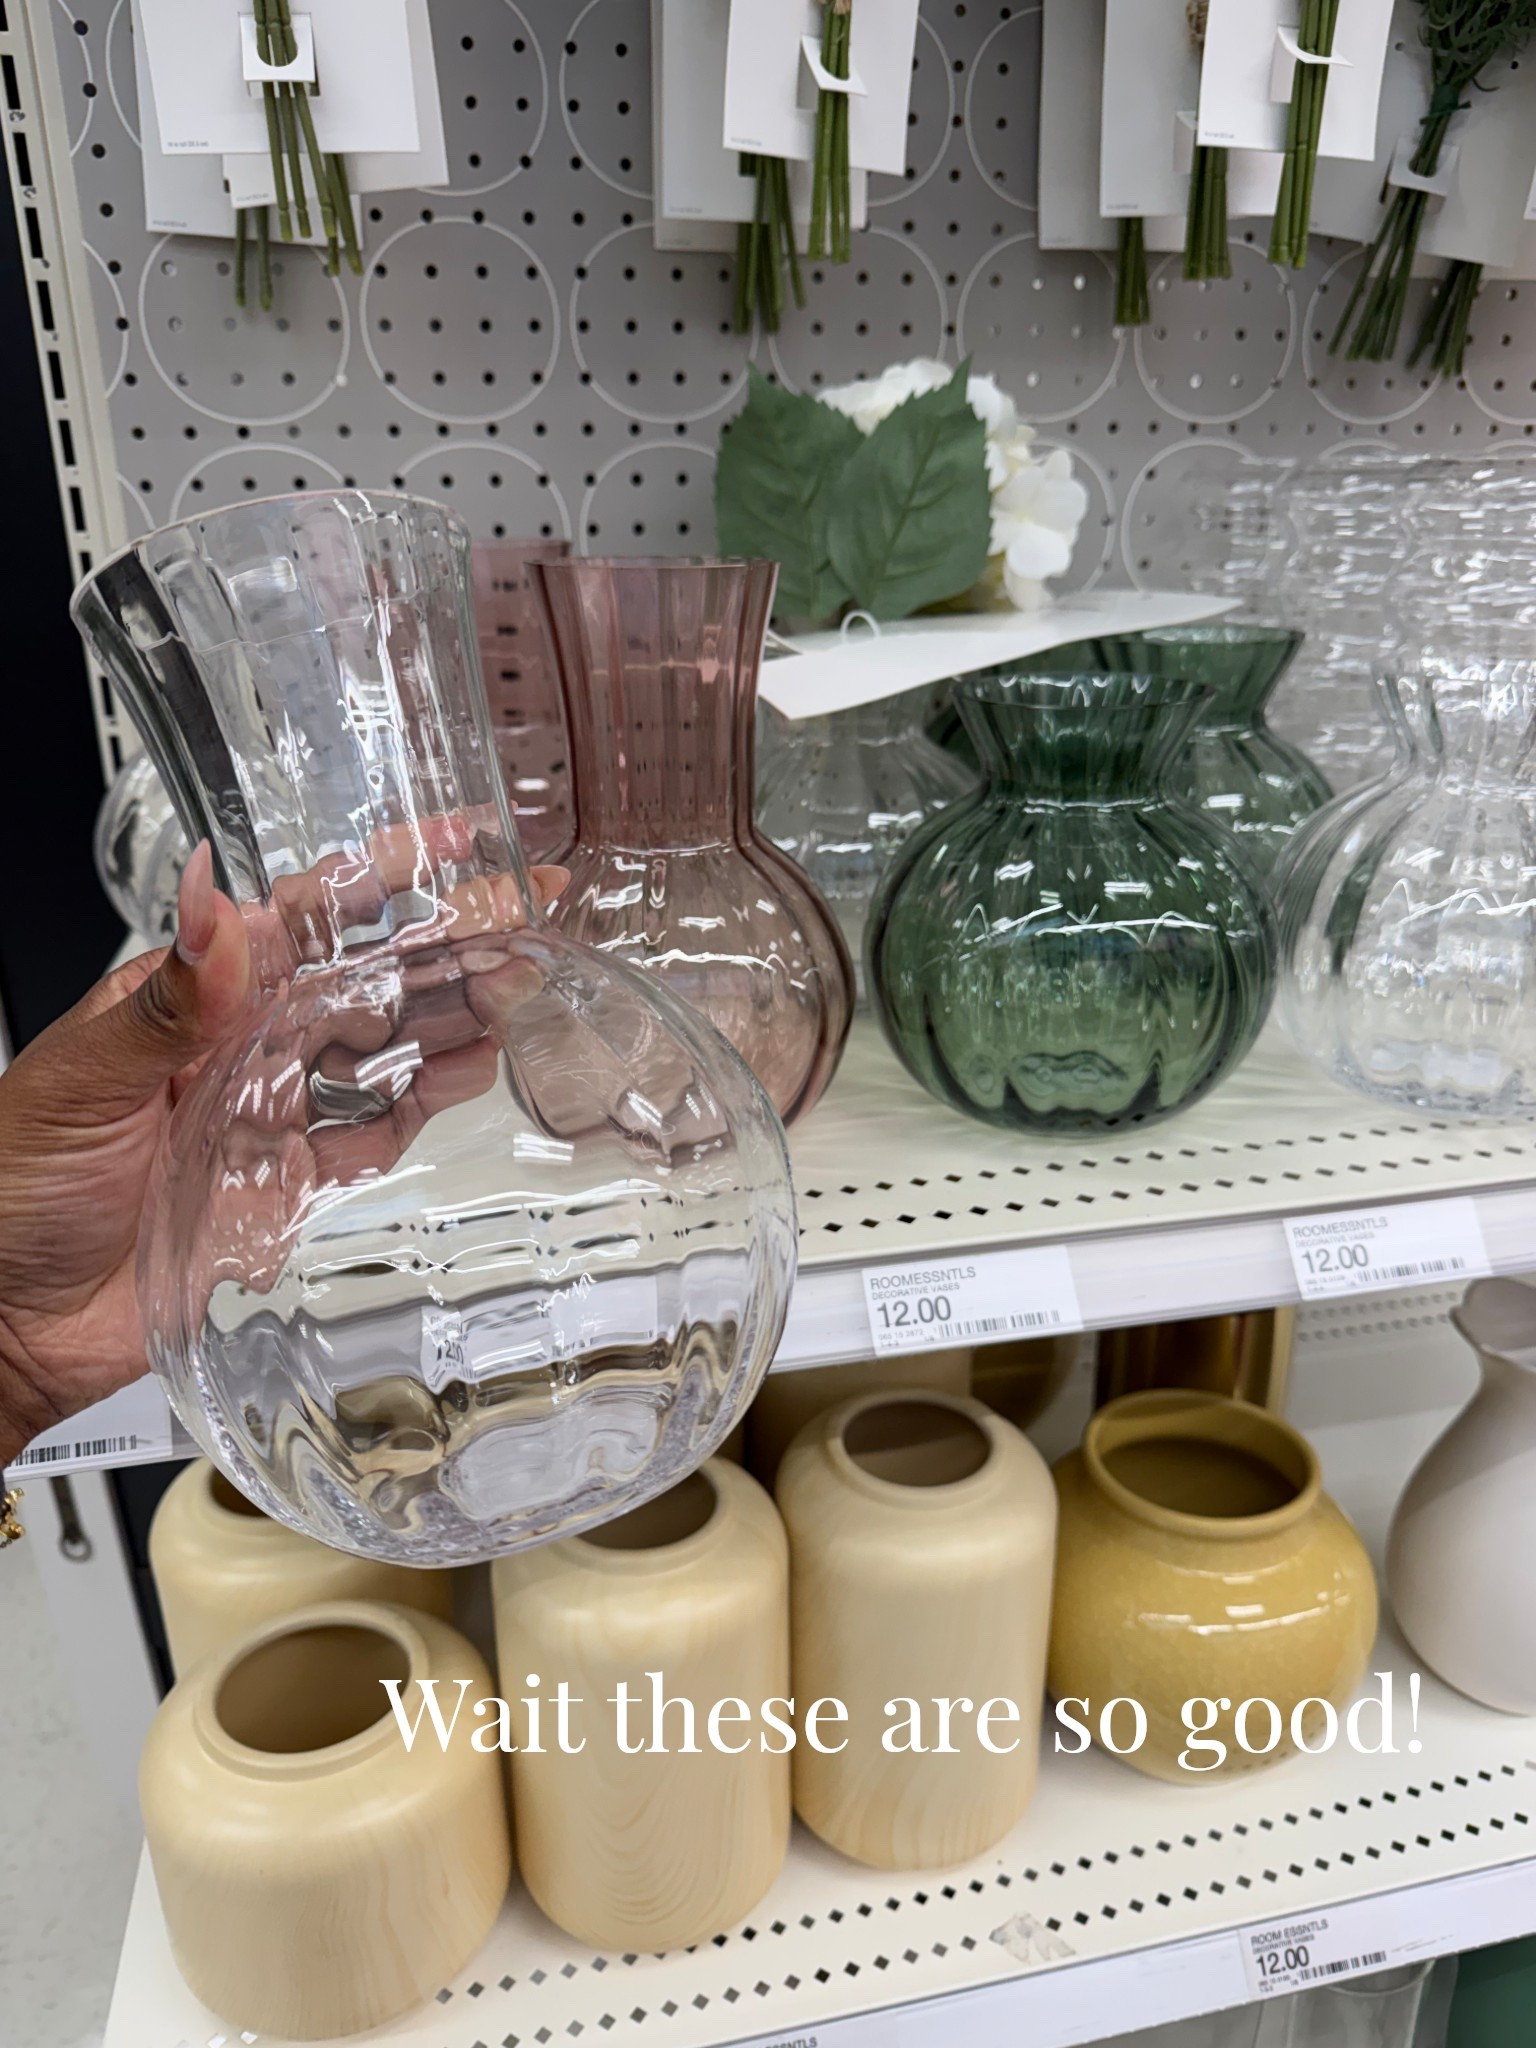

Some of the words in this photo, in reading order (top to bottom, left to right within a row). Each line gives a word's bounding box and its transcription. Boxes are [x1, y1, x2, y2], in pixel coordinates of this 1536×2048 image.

[1292, 1216, 1388, 1239] ROOMESSNTLS
[1302, 1244, 1369, 1273] 12.00
[870, 1266, 977, 1290] ROOMESSNTLS
[872, 1285, 929, 1300] DECORATIVE
[930, 1282, 960, 1293] VASES
[876, 1295, 951, 1328] 12.00
[1250, 1929, 1282, 1945] ROOM
[1283, 1919, 1328, 1938] ESSNTLS
[1257, 1945, 1309, 1976] 12.00
